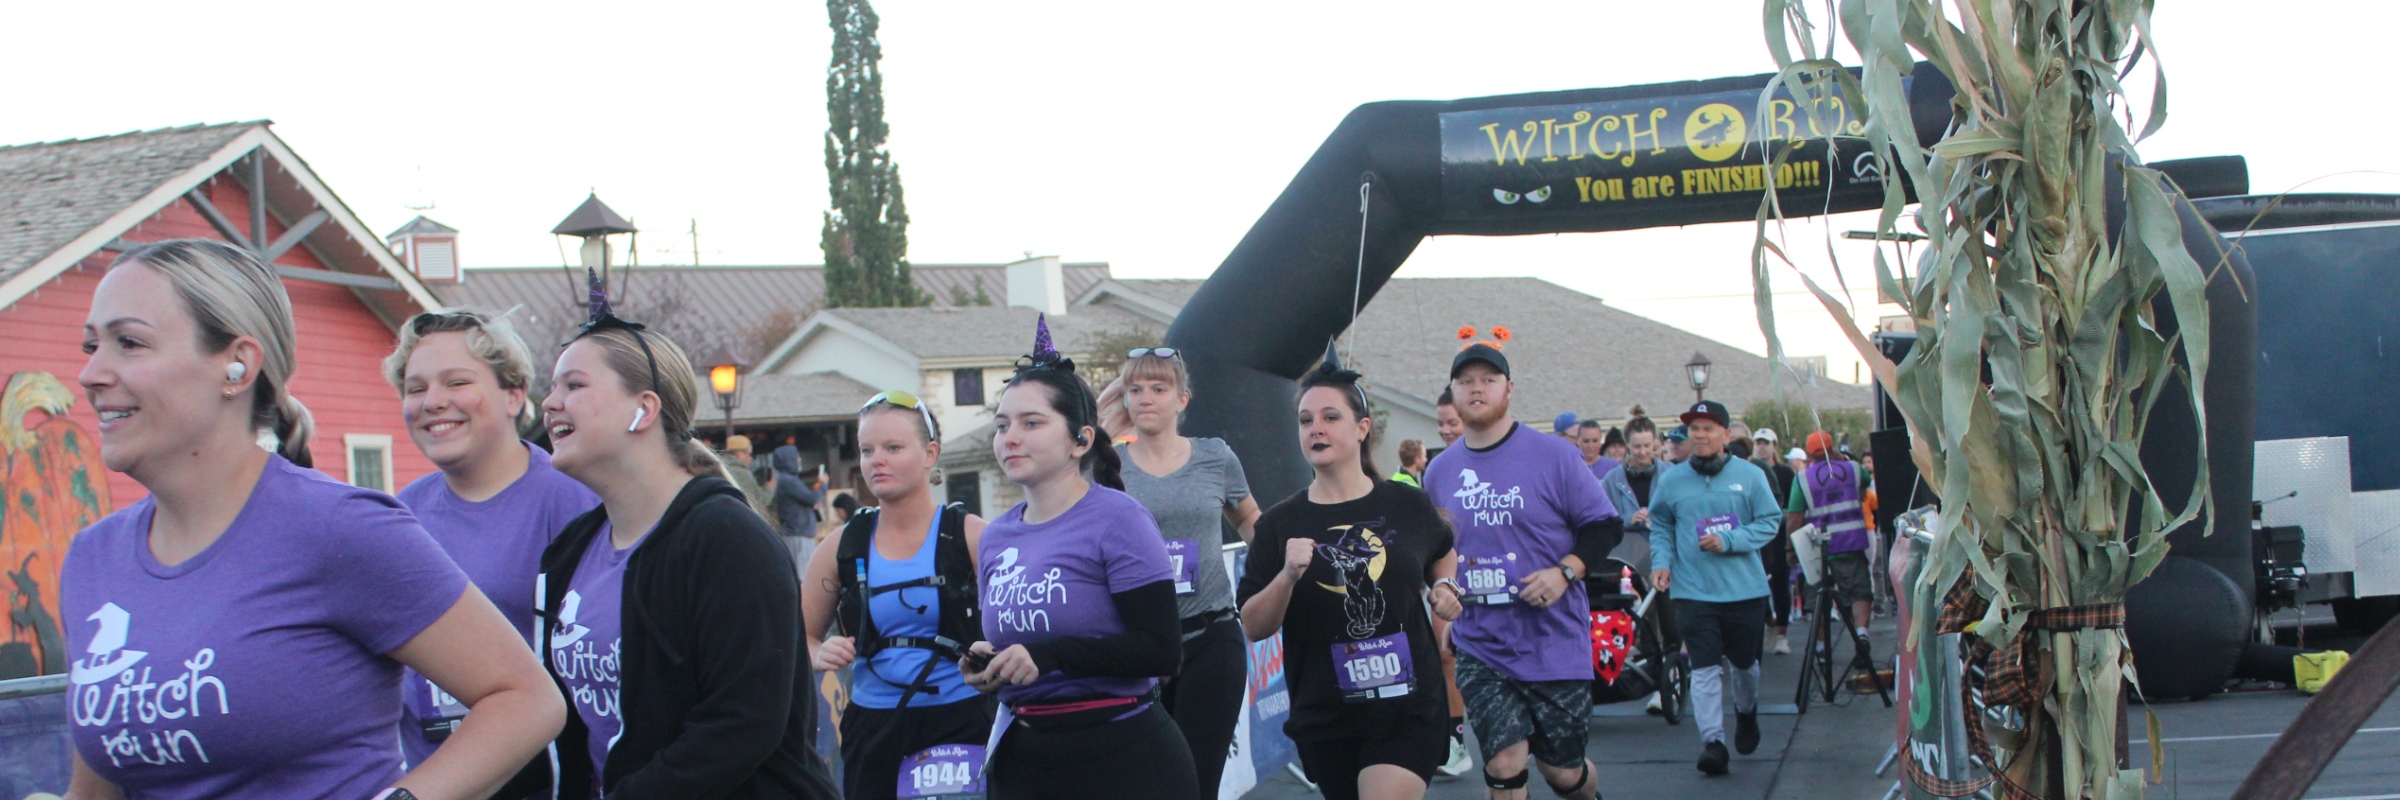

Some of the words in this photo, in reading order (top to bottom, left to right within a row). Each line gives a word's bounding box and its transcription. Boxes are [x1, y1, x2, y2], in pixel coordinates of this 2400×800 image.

[1479, 107, 1668, 167] WITCH
[1575, 176, 1625, 203] You
[1632, 174, 1675, 199] are
[1474, 509, 1512, 527] run
[1464, 568, 1507, 589] 1586
[998, 607, 1050, 633] run
[1358, 641, 1377, 651] Witch
[1378, 638, 1393, 648] Run
[1344, 652, 1401, 683] 1590
[101, 729, 210, 769] run
[930, 747, 950, 757] Witch
[952, 746, 968, 757] Run
[910, 761, 971, 789] 1944
